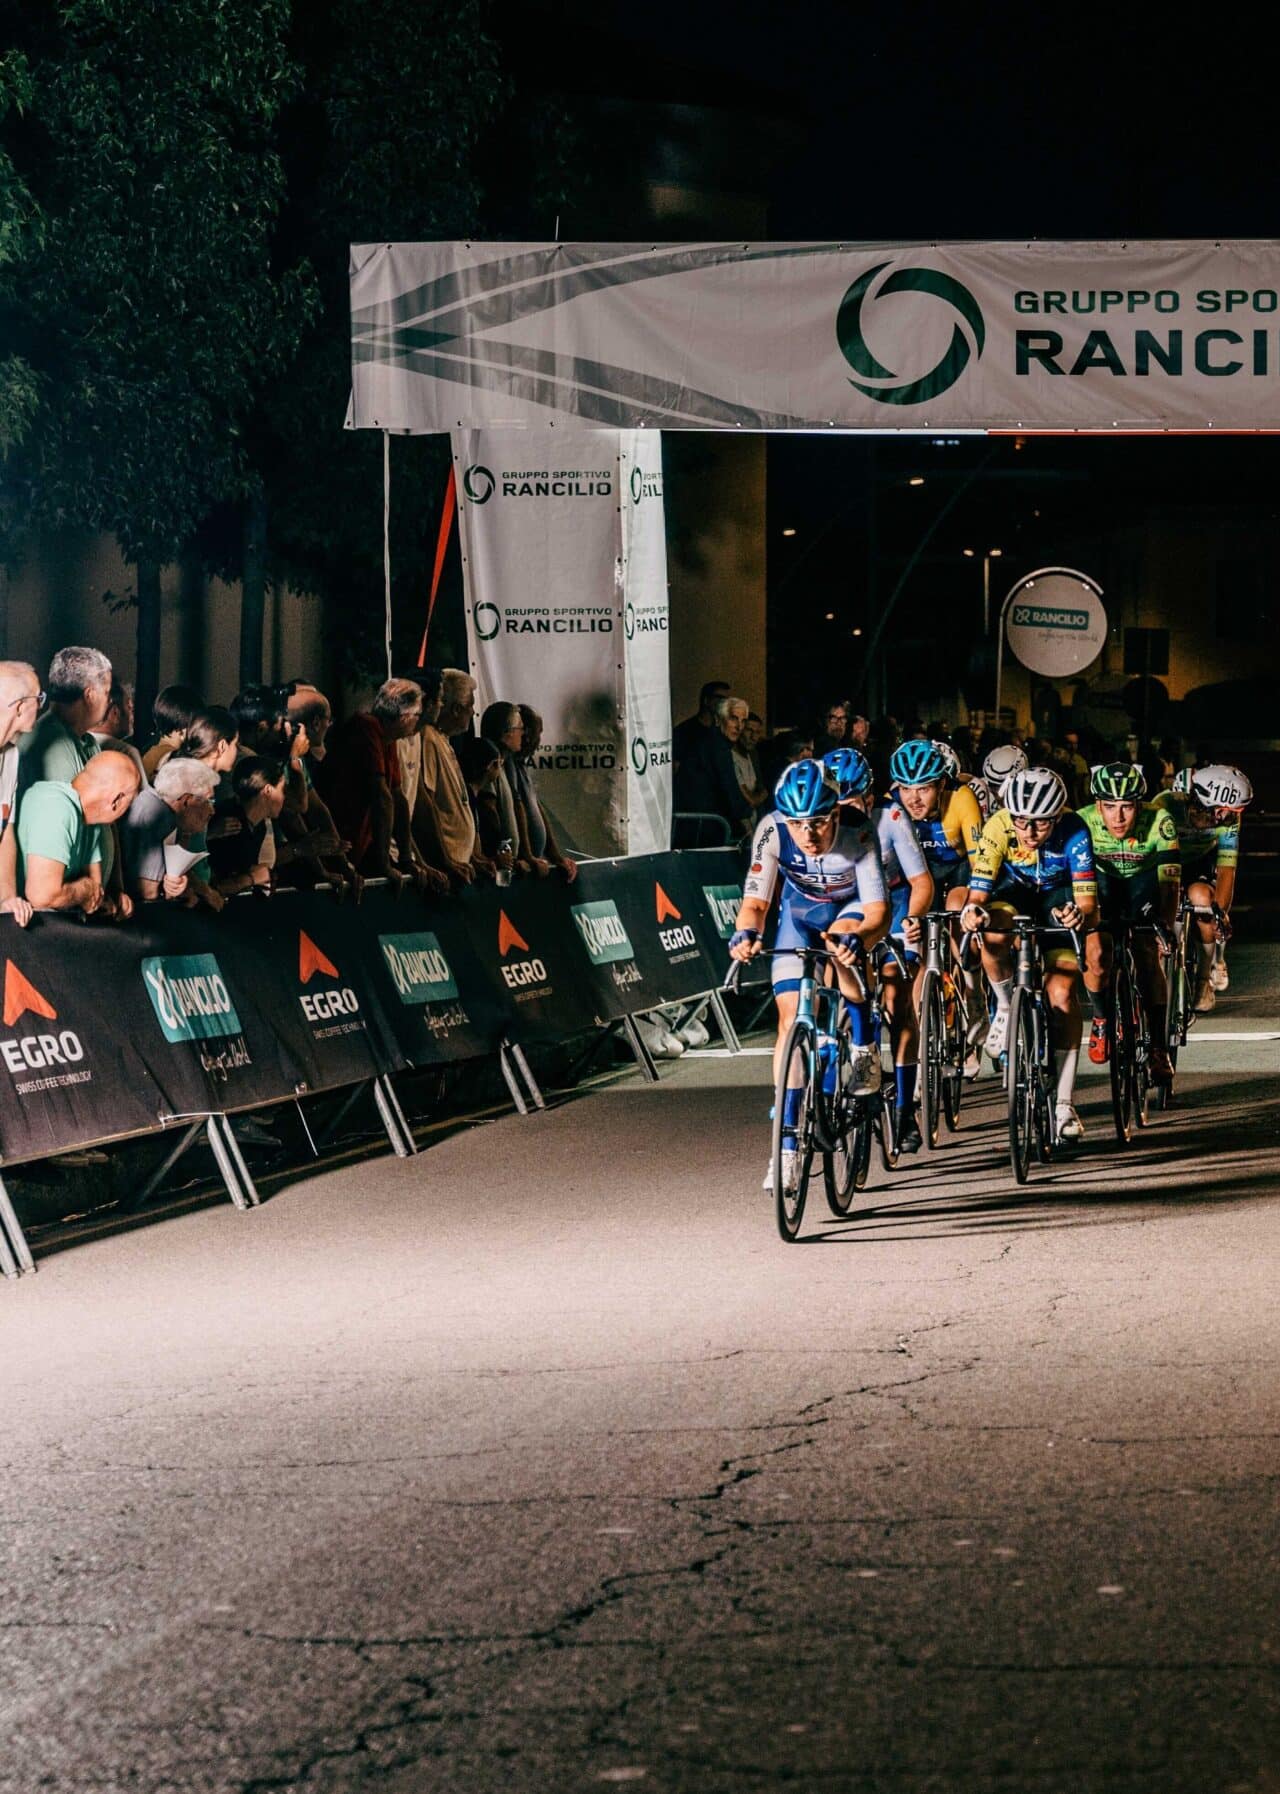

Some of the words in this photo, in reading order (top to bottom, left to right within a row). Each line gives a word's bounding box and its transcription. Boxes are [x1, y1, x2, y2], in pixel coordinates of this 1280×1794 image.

[1014, 290, 1180, 313] GRUPPO
[502, 471, 549, 479] GRUPPO
[552, 471, 611, 479] SPORTIVO
[502, 482, 611, 496] RANCILIO
[504, 608, 549, 616] GRUPPO
[553, 607, 612, 616] SPORTIVO
[1032, 611, 1086, 626] RANCILIO
[505, 618, 613, 633] RANCILIO
[555, 743, 616, 753] SPORTIVO
[1213, 785, 1238, 805] 106
[659, 925, 696, 951] EGRO
[500, 958, 547, 988] EGRO
[299, 988, 359, 1021] EGRO
[0, 1030, 84, 1073] EGRO
